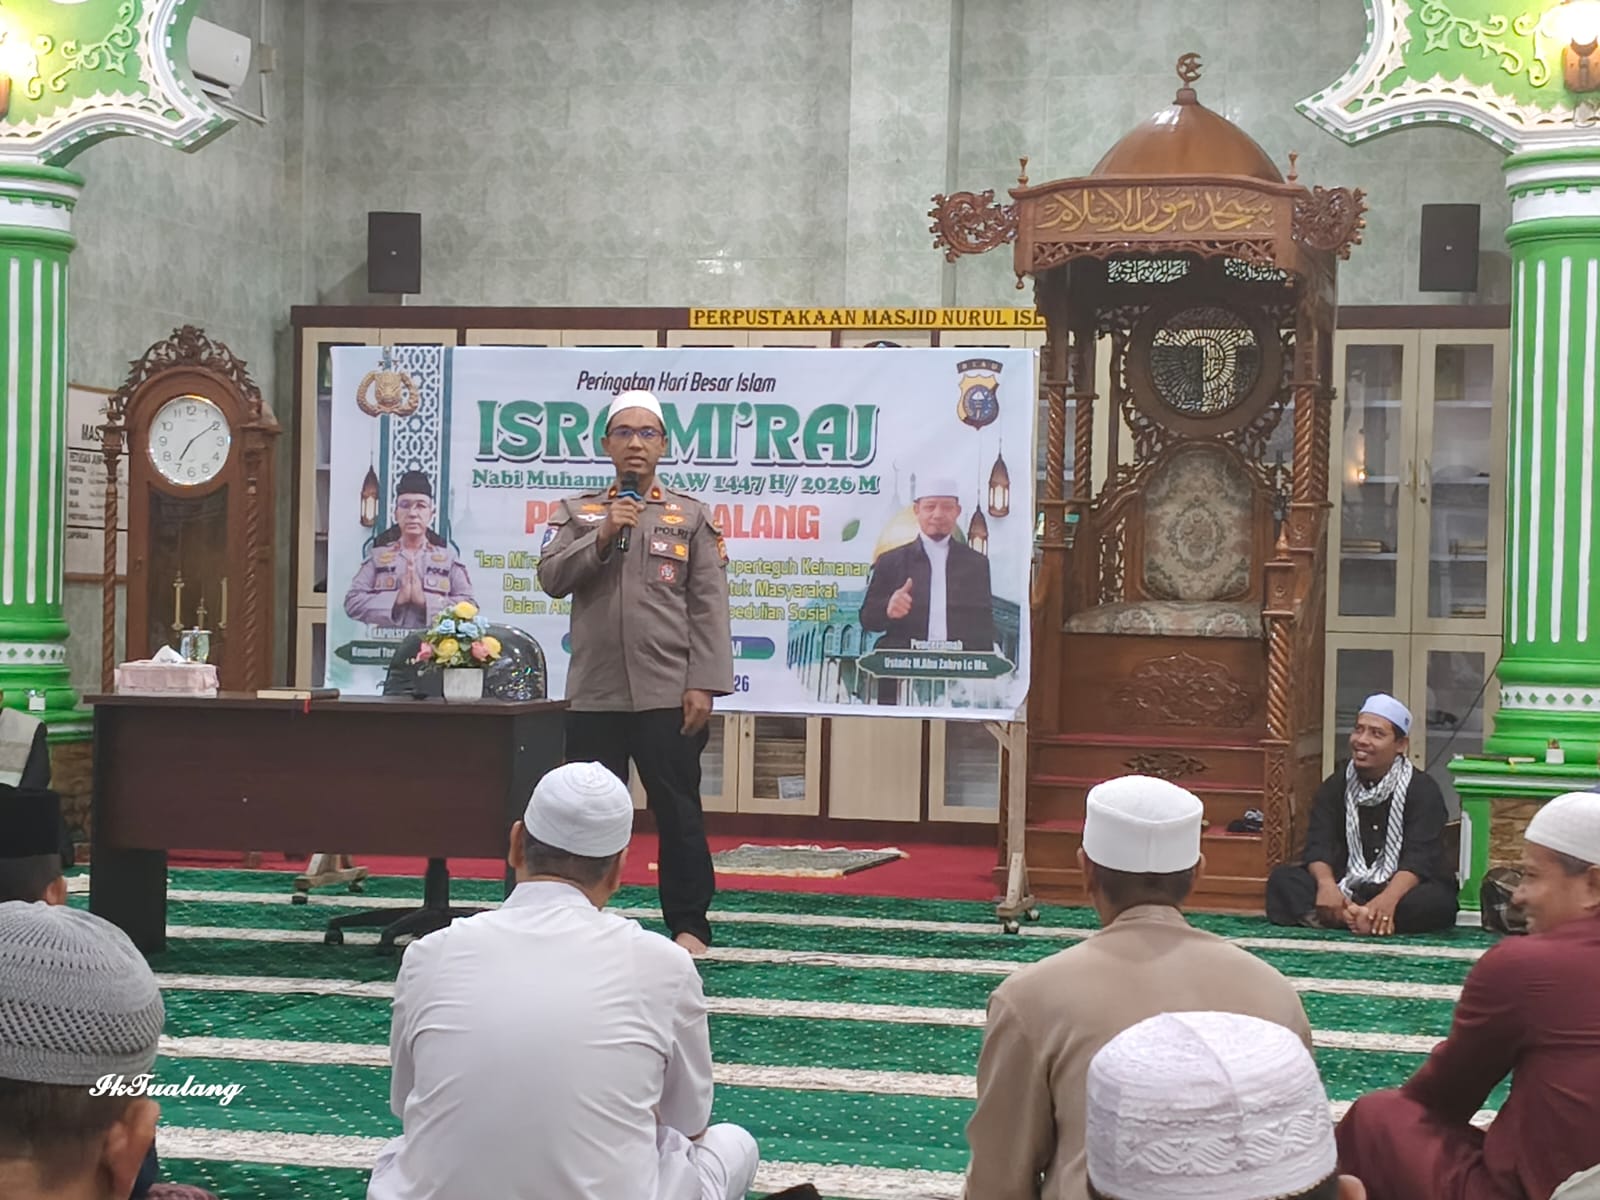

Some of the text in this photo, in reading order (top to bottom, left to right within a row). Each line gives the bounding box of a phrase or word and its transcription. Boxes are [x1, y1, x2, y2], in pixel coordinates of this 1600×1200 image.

[693, 309, 1045, 326] PERPUSTAKAAN MASJID NURUL ISL
[576, 370, 777, 396] Peringatan Hari Besar Islam
[173, 408, 182, 418] 11
[186, 405, 197, 416] 12
[203, 408, 209, 418] 1
[161, 421, 174, 432] 10
[159, 436, 168, 447] 9
[216, 436, 225, 447] 3
[163, 451, 172, 461] 8
[175, 463, 182, 473] 7
[187, 467, 196, 477] 6
[201, 463, 210, 473] 5
[472, 469, 523, 489] Nabi
[527, 470, 610, 490] Muhamm
[712, 475, 765, 495] 1447
[802, 476, 856, 495] 2026
[857, 475, 880, 495] M
[712, 503, 820, 540] ALANG
[654, 526, 689, 540] POLRI
[728, 557, 799, 579] perteguh
[802, 557, 871, 577] Keimanan
[503, 573, 531, 592] Dan
[729, 579, 752, 596] tuk
[755, 579, 839, 600] Masyarakat
[503, 595, 546, 614] Dalam
[734, 674, 750, 692] 26
